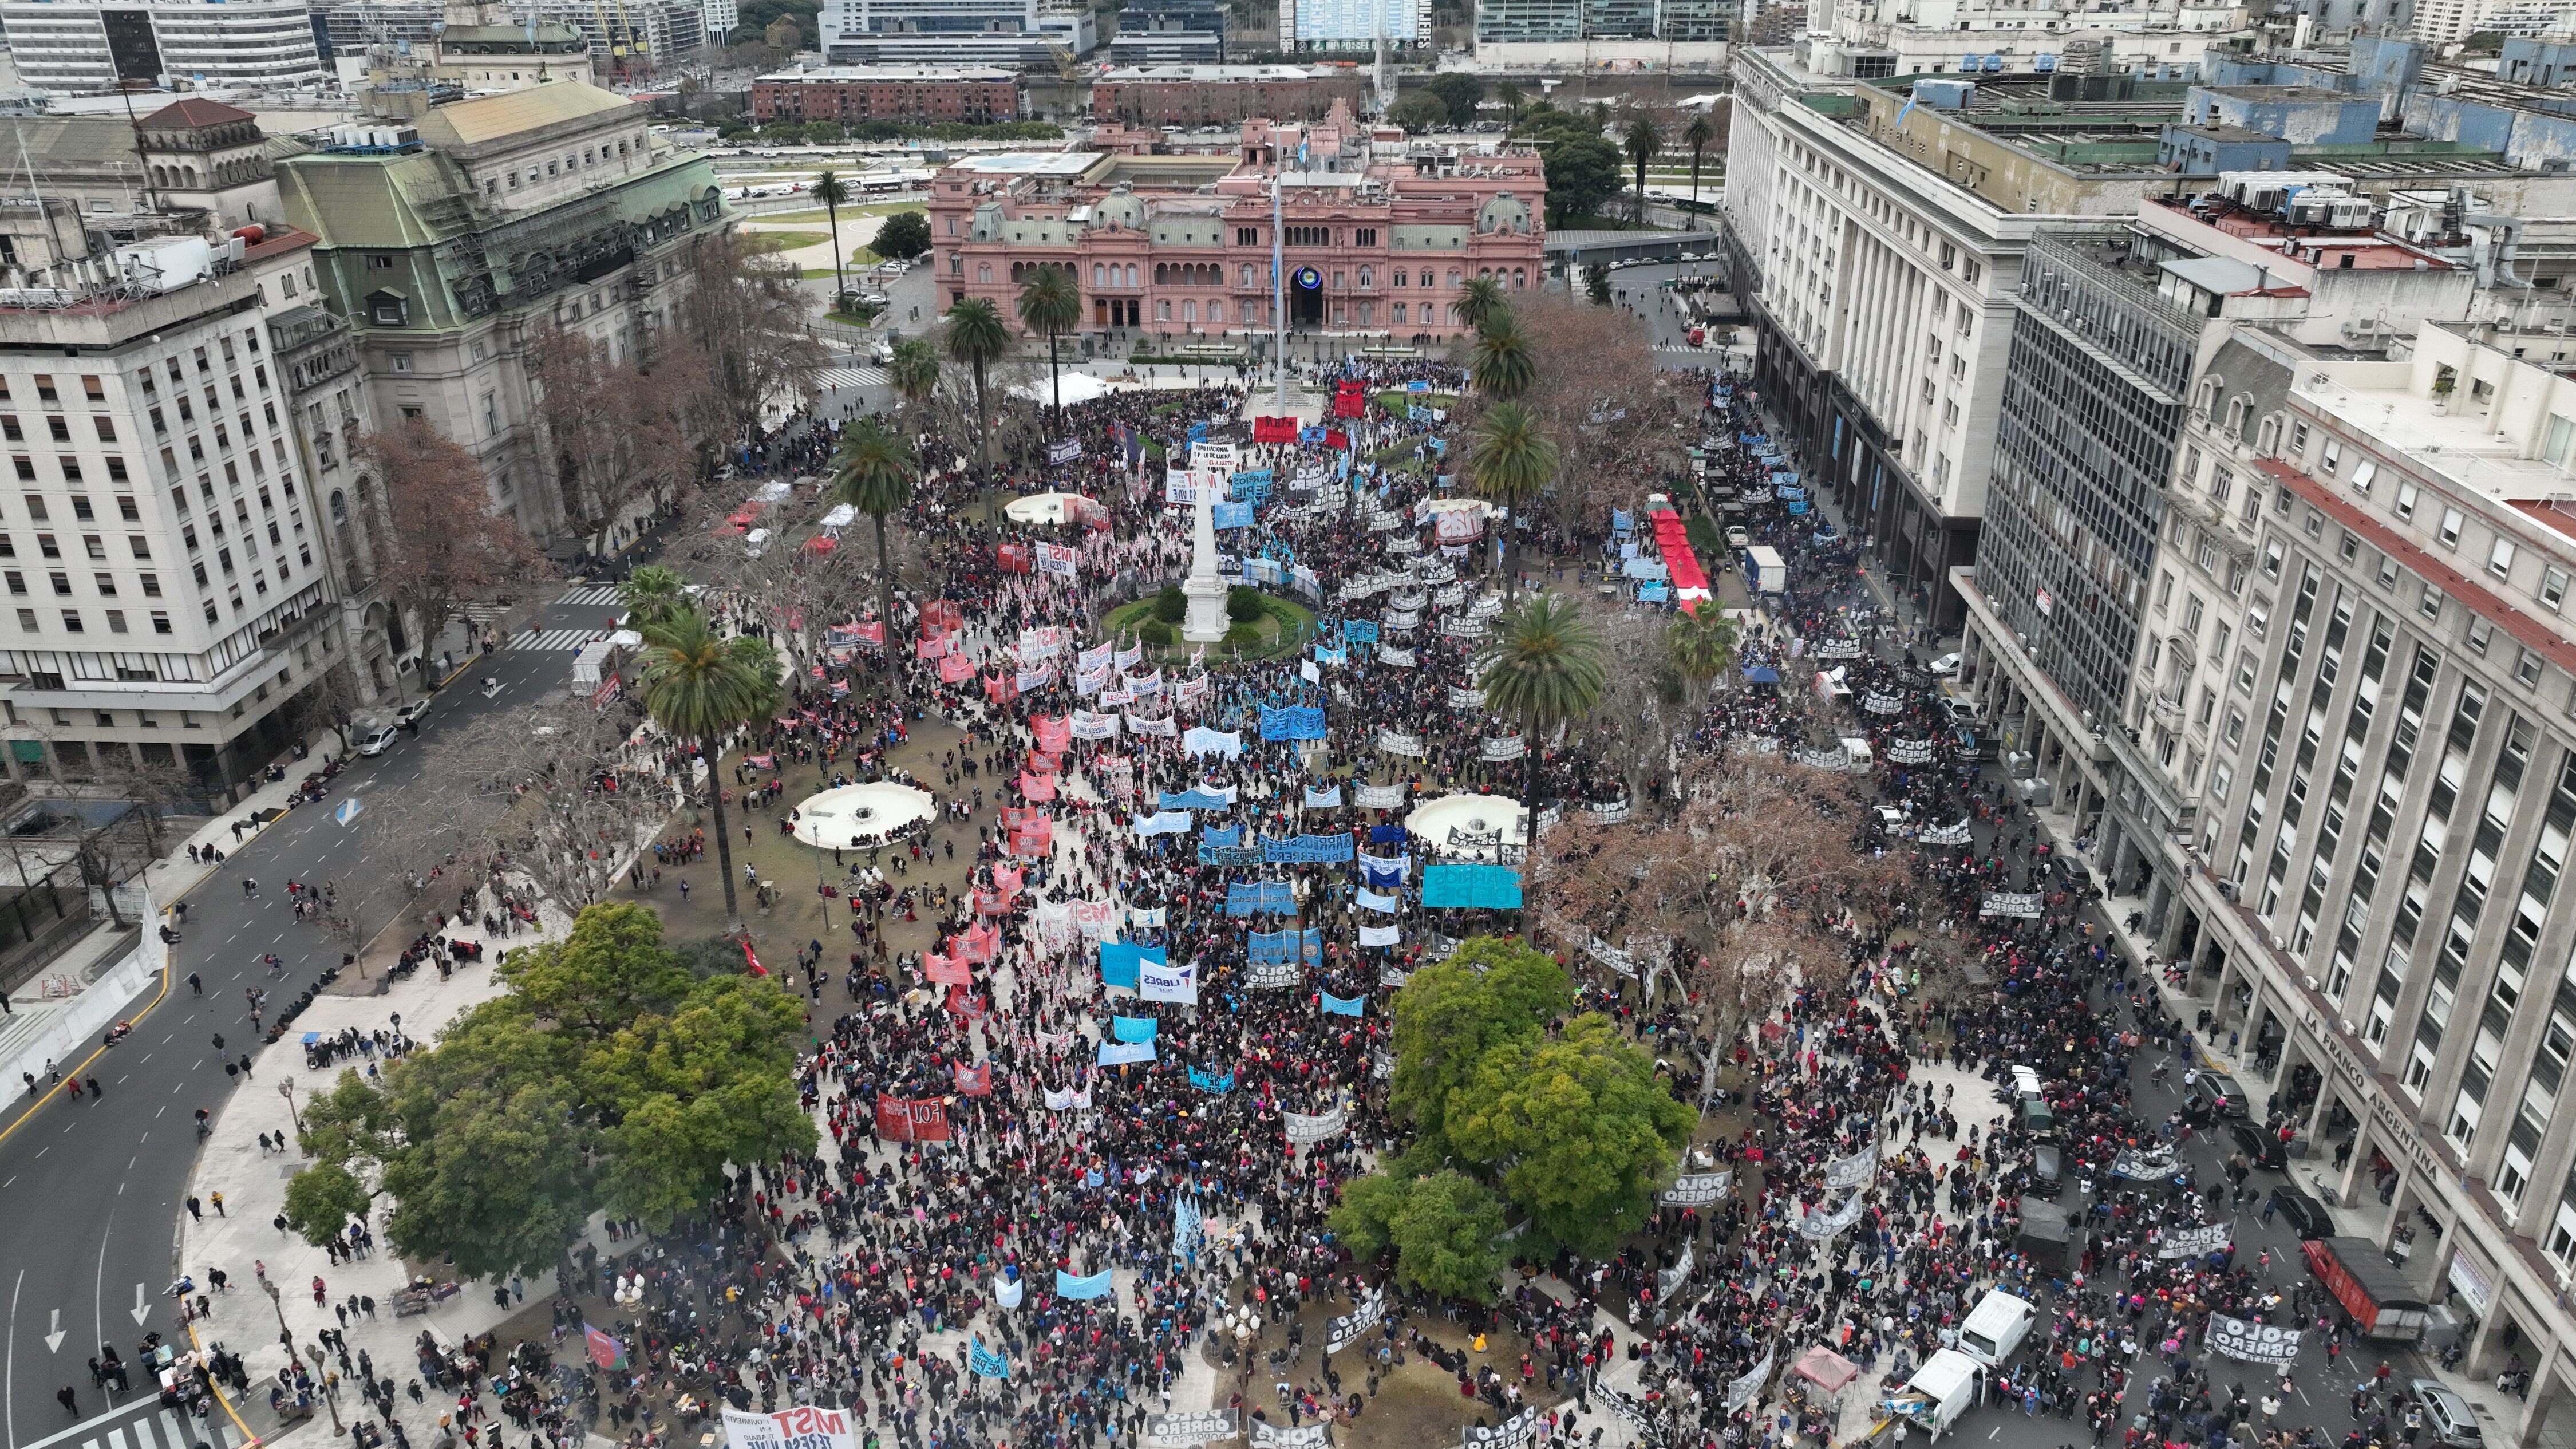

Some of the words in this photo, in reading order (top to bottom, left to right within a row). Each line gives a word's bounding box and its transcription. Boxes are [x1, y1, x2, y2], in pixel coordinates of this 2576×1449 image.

[1417, 0, 1431, 49] MUJERES
[1341, 41, 1370, 50] POSEE
[1051, 442, 1081, 462] PUEBLOS
[2305, 1011, 2317, 1033] LA
[2322, 1032, 2365, 1087] FRANCO
[2368, 1092, 2437, 1181] ARGENTINA
